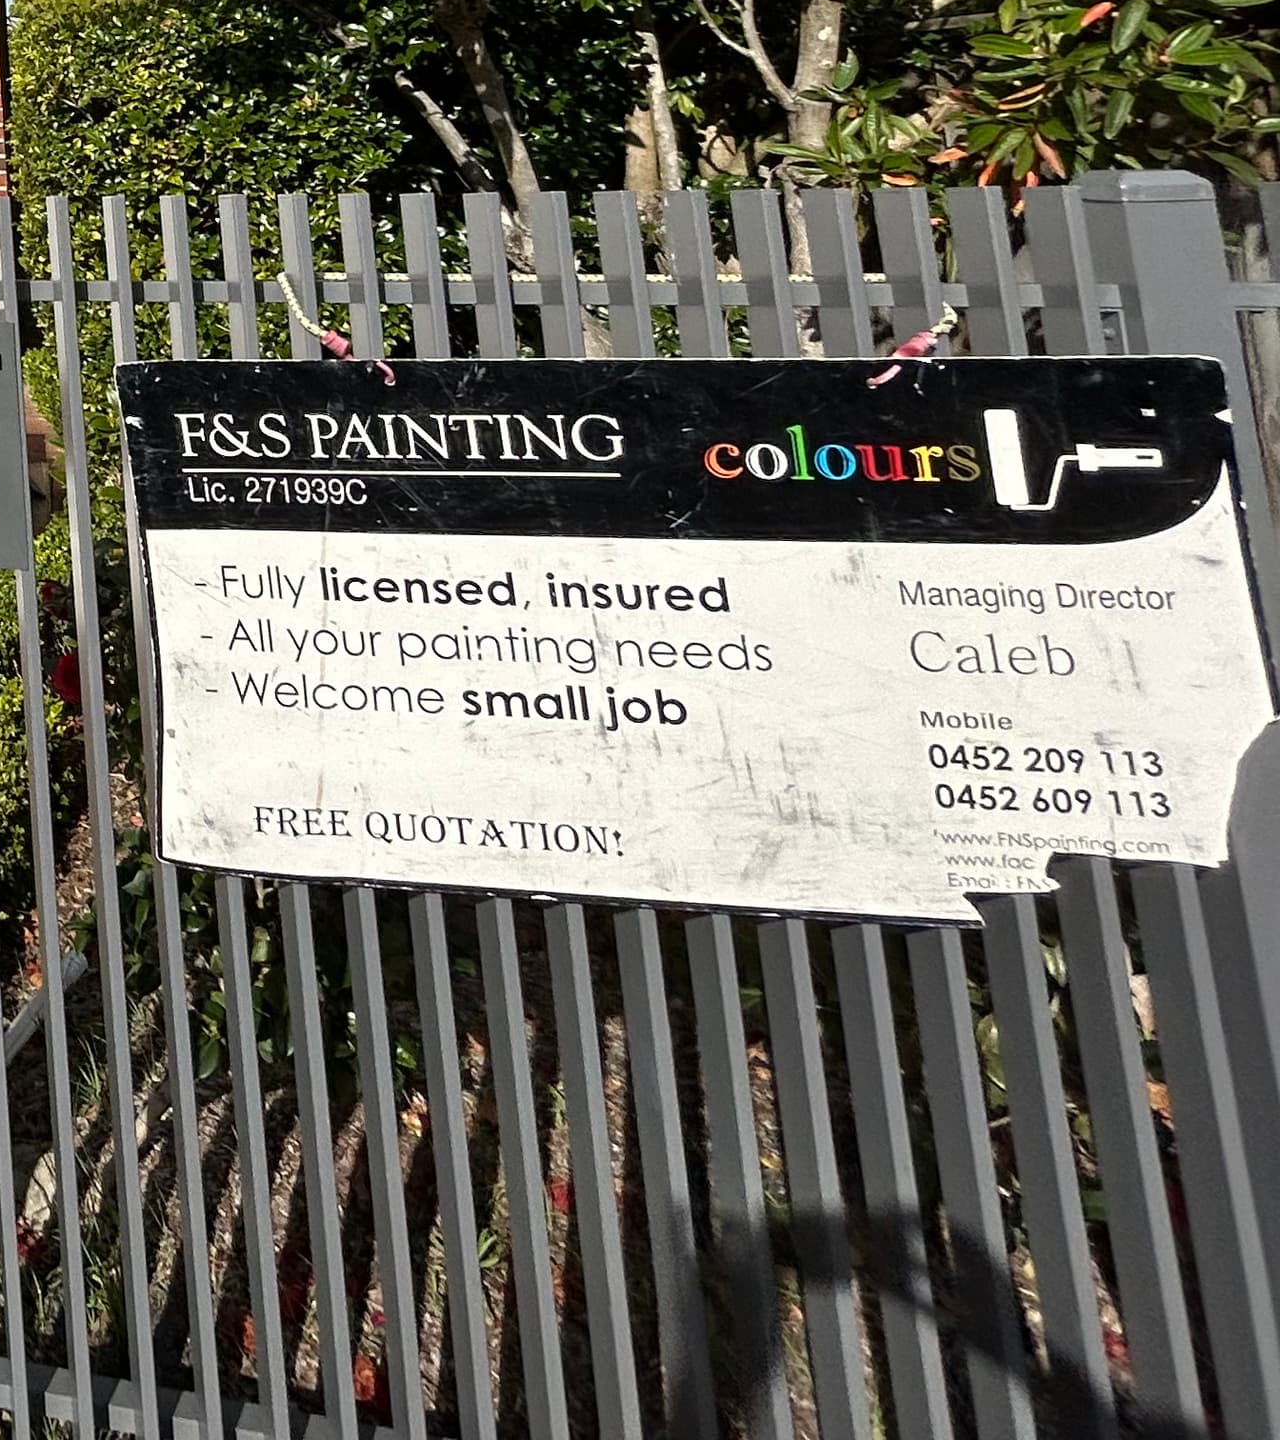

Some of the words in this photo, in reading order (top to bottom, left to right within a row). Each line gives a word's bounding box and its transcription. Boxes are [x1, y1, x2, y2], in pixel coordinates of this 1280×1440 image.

[173, 412, 292, 458] F&S
[304, 412, 625, 462] PAINTING
[704, 424, 981, 482] colours
[187, 476, 236, 503] Lic.
[244, 476, 368, 505] 271939C
[220, 564, 306, 608] Fully
[319, 566, 531, 611] licensed,
[545, 572, 731, 613] insured
[898, 580, 1046, 614] Managing
[1054, 582, 1177, 610] Director
[228, 618, 275, 653] All
[286, 628, 382, 663] your
[397, 625, 598, 674] painting
[615, 633, 774, 672] needs
[910, 630, 1076, 677] Caleb
[231, 671, 445, 714] Welcome
[462, 685, 591, 721] small
[605, 686, 688, 732] job
[919, 710, 1014, 731] Mobile
[927, 743, 1014, 772] 0452
[1023, 746, 1085, 774] 209
[1100, 750, 1164, 778] 113
[934, 783, 1021, 812] 0452
[1032, 787, 1093, 815] 609
[1108, 790, 1172, 819] 113
[252, 805, 353, 838] FREE
[364, 811, 625, 858] QUOTATION!
